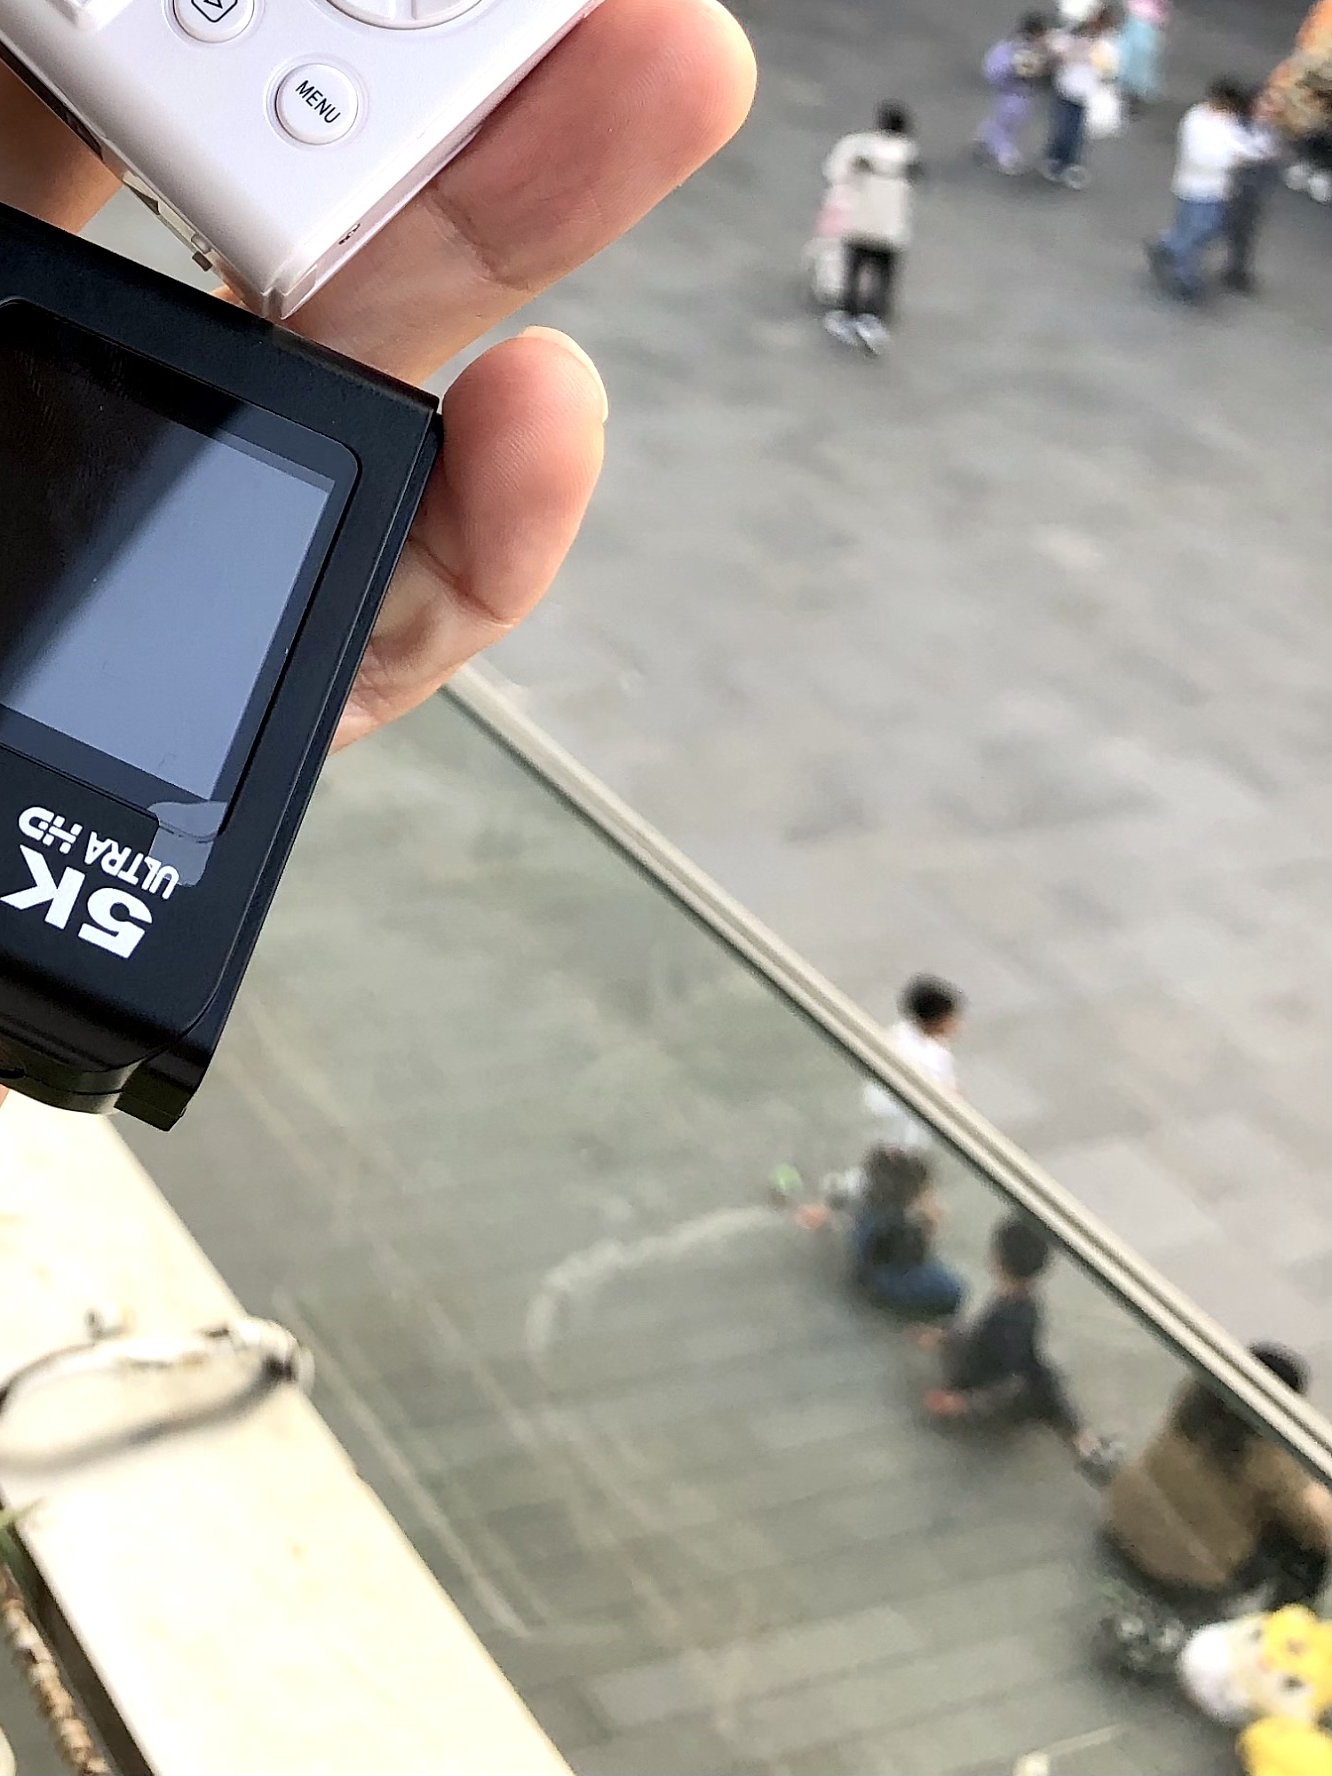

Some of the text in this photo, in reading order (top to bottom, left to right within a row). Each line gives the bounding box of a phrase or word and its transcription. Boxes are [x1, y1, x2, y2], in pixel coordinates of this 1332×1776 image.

[295, 80, 341, 124] MENU
[18, 806, 180, 901] ULTRA HD
[0, 844, 154, 959] 5K
